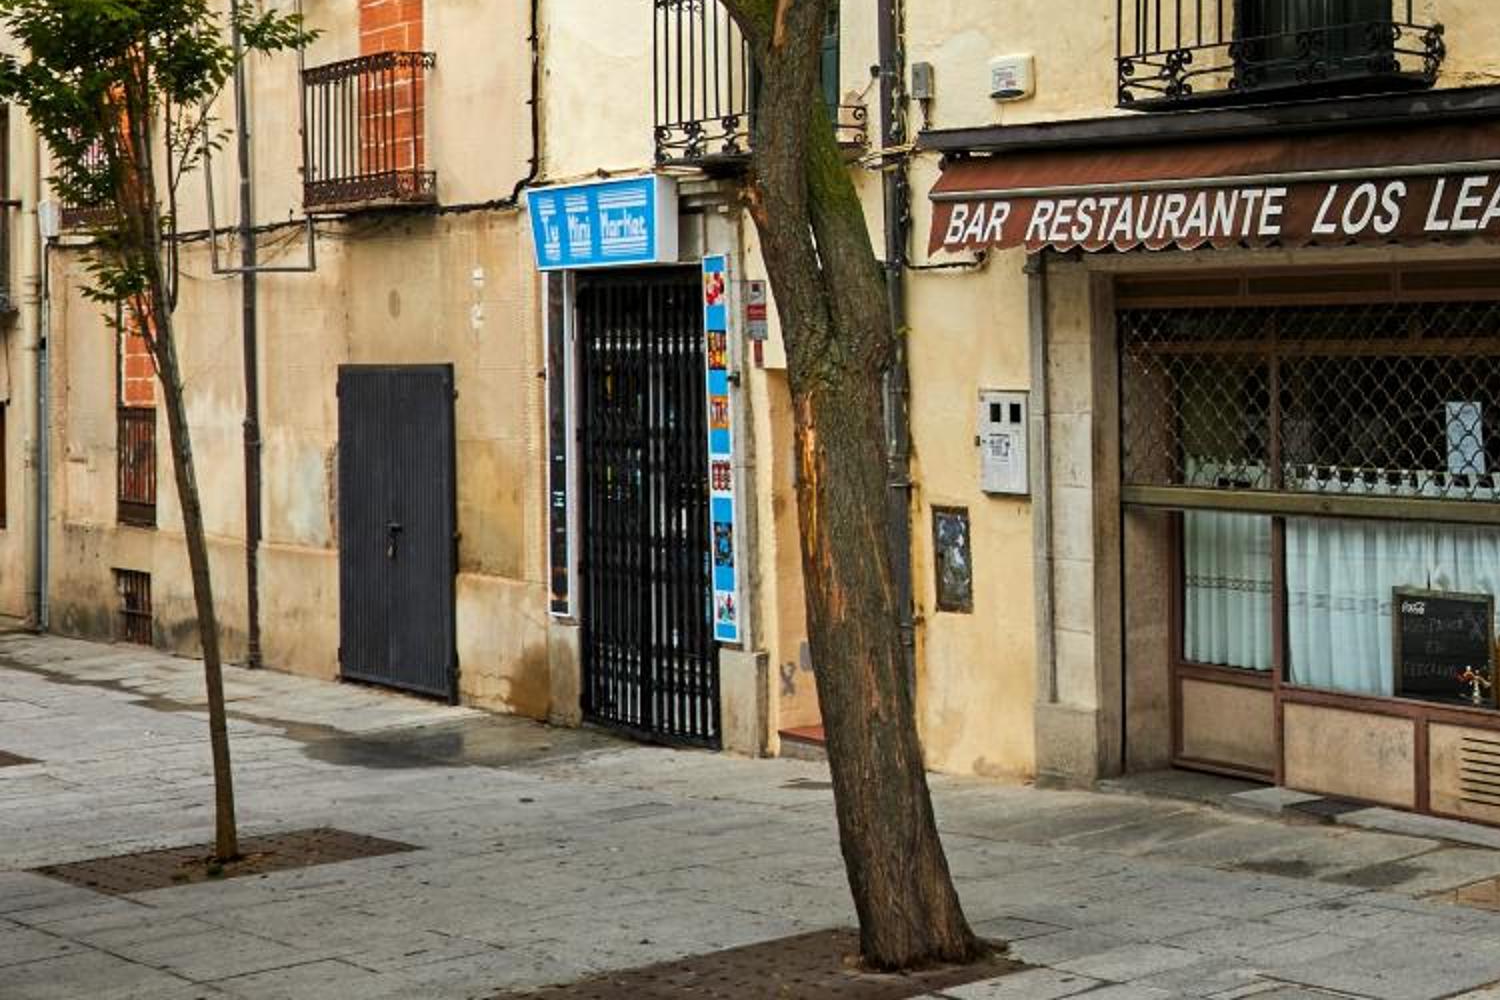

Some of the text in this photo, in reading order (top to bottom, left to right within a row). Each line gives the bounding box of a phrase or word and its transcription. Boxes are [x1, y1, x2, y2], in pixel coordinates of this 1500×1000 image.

[541, 207, 647, 244] Tu Mini Market
[943, 201, 1010, 245] BAR
[1025, 187, 1287, 242] RESTAURANTE
[1311, 180, 1407, 235] LOS
